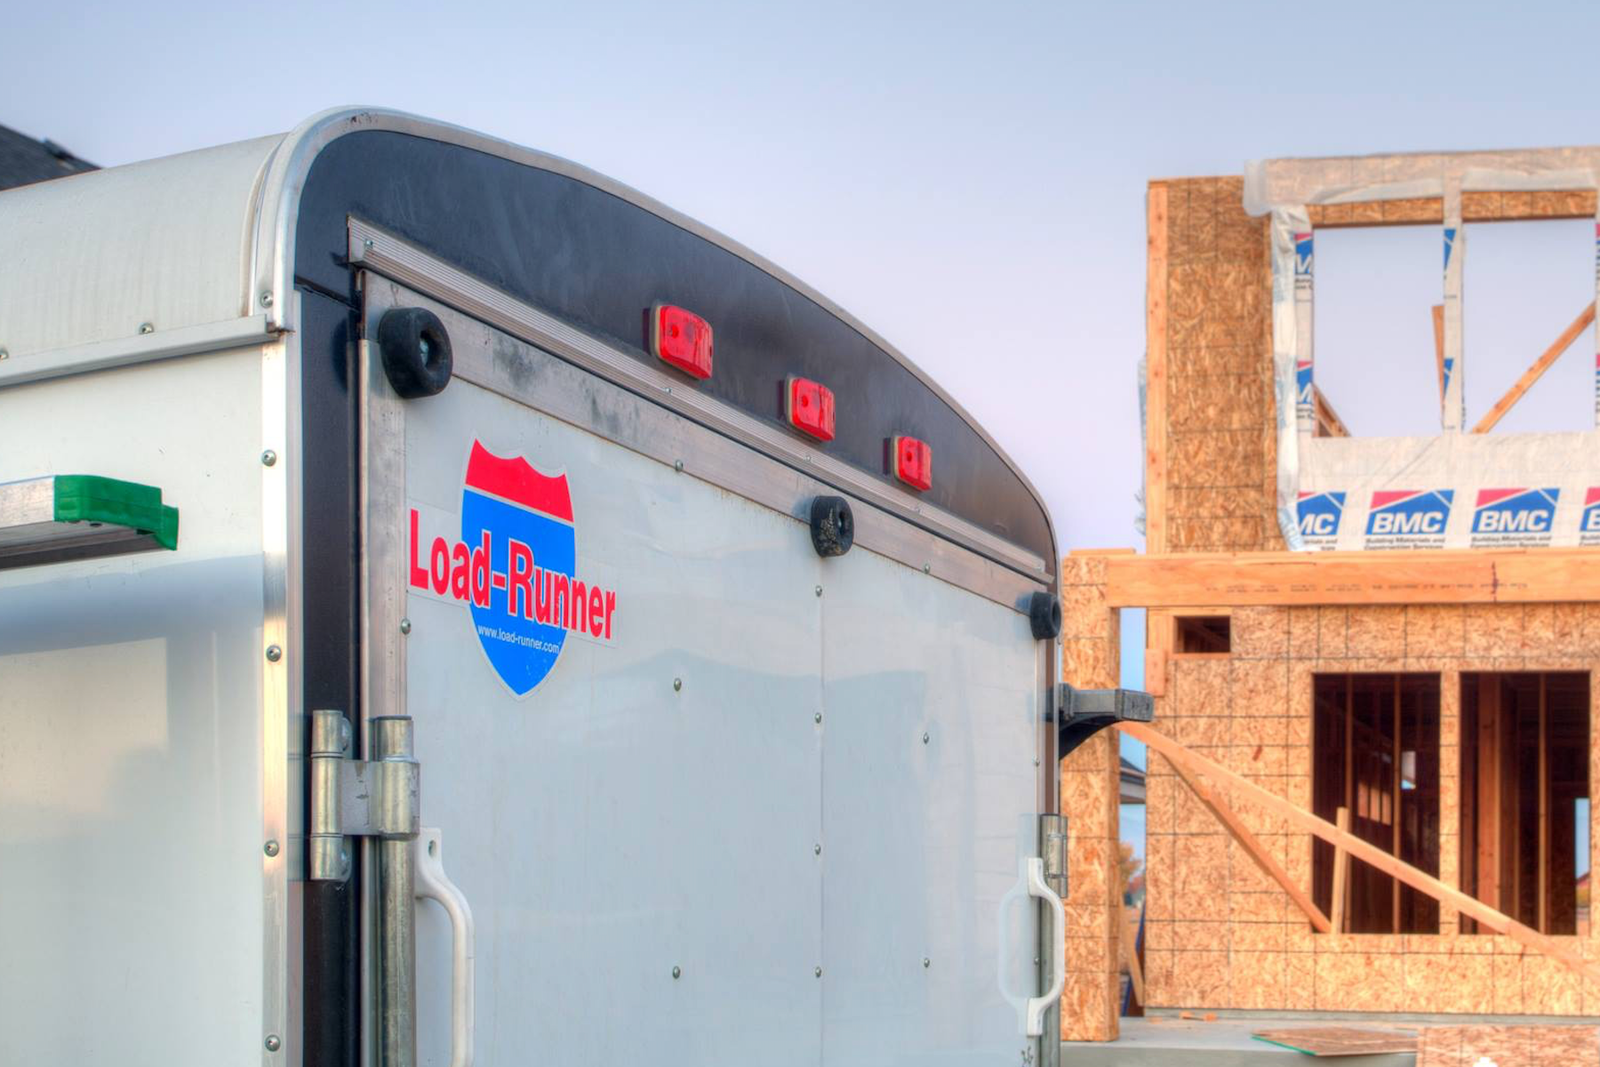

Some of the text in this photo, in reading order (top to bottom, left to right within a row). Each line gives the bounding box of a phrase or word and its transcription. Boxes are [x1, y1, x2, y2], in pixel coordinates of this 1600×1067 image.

[1300, 513, 1335, 534] MC
[1373, 511, 1443, 534] BMC
[1478, 510, 1549, 532] BMC
[410, 508, 615, 639] Load-Runner
[478, 625, 560, 653] www.load-runner.com
